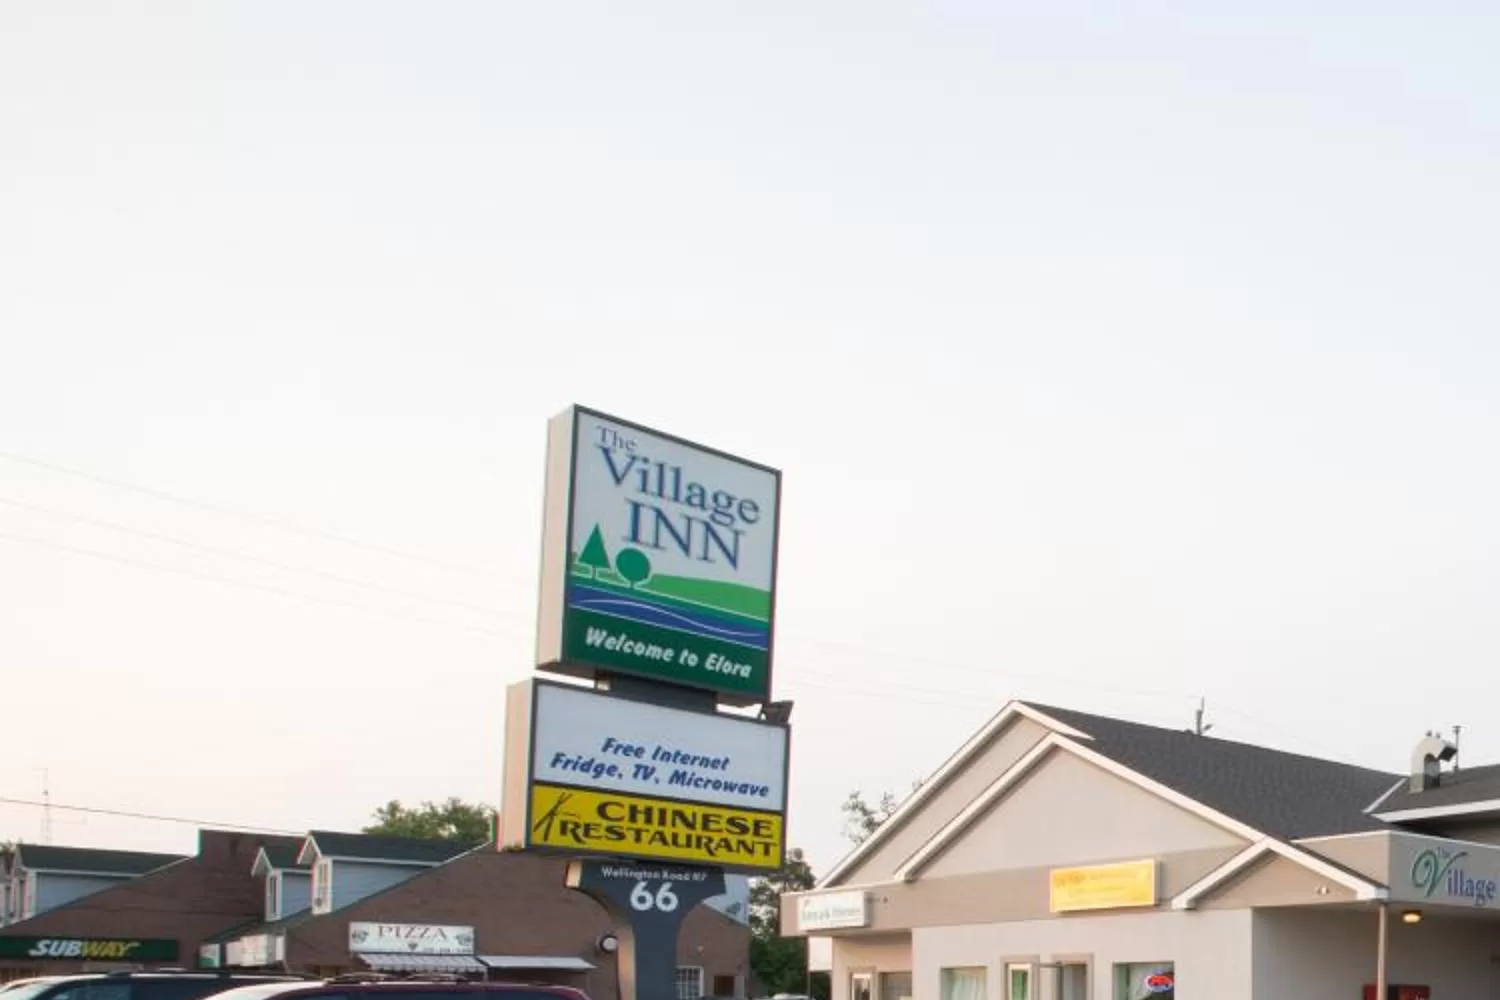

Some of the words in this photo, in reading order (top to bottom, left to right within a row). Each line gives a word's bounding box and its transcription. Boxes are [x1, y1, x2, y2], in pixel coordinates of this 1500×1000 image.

[596, 425, 638, 452] The
[595, 443, 761, 527] Village
[622, 497, 746, 572] INN
[586, 626, 674, 662] Welcome
[679, 648, 699, 667] to
[704, 652, 752, 678] Elora
[601, 737, 644, 759] Free
[651, 745, 730, 772] Internet
[551, 752, 623, 779] Fridge,
[668, 770, 769, 798] Microwave
[559, 819, 777, 857] RESTAURANT
[597, 801, 774, 839] CHINESE
[630, 881, 679, 912] 66
[1410, 849, 1497, 906] Village
[28, 939, 141, 957] SUBWAY
[377, 925, 448, 940] PIZZA
